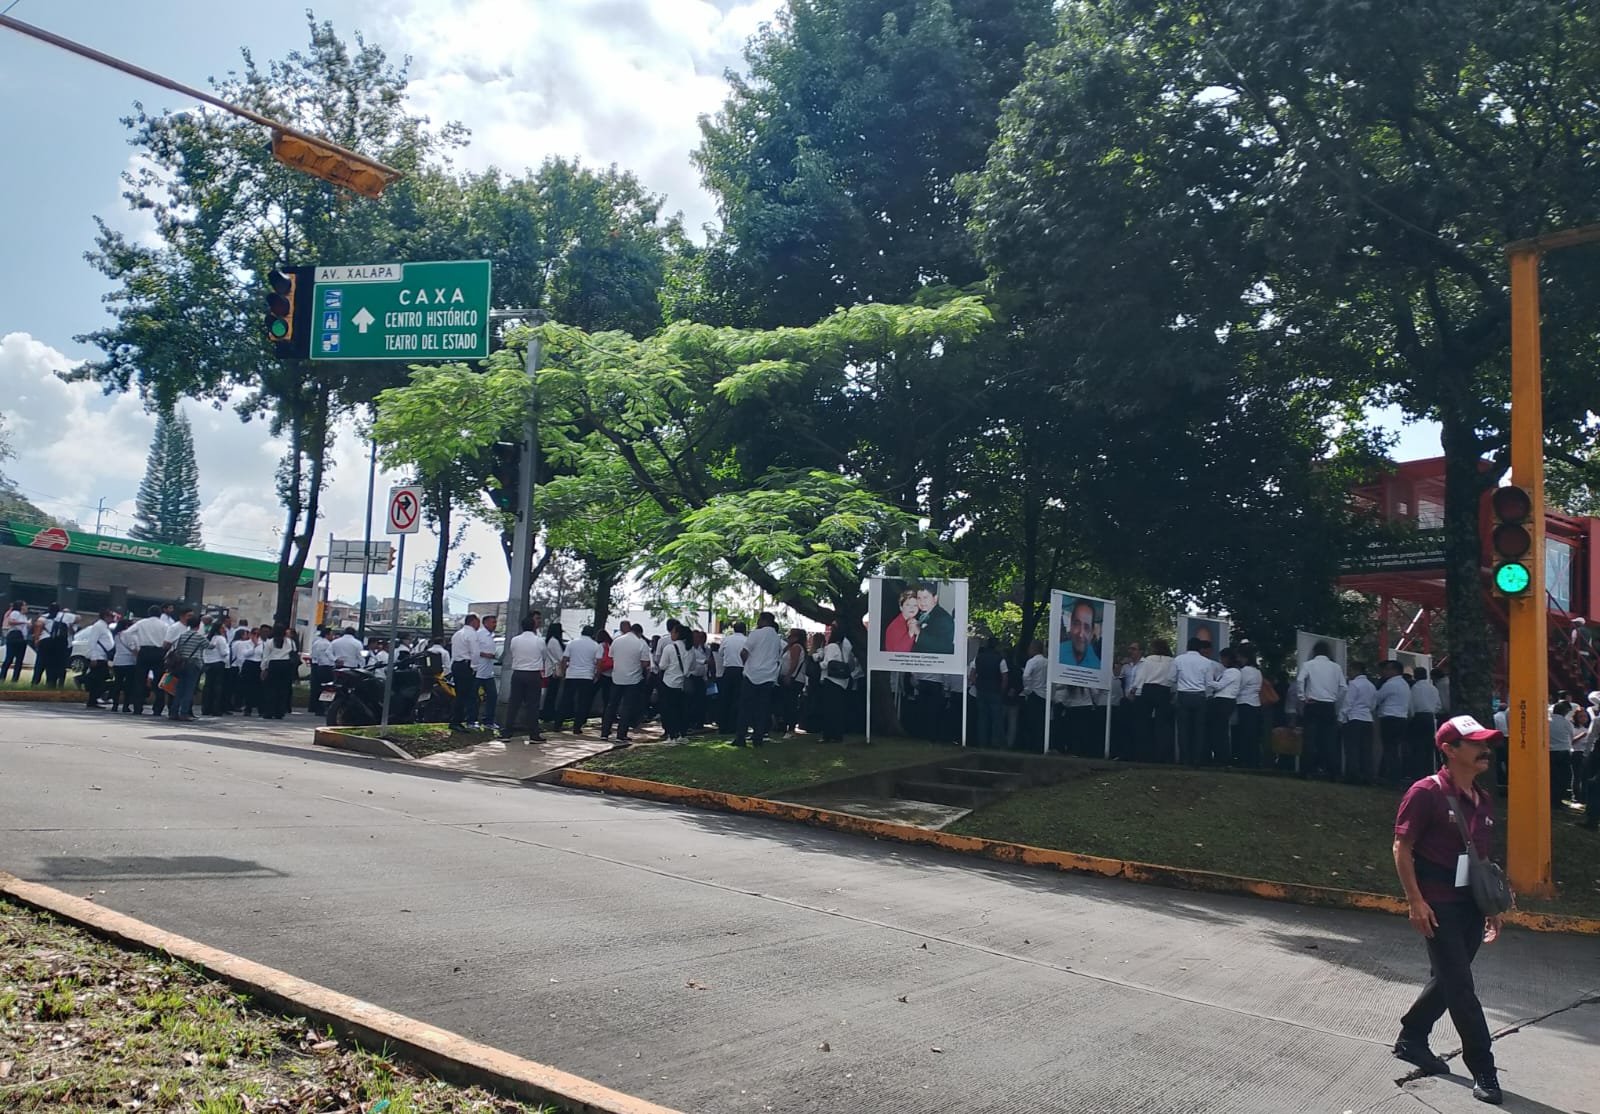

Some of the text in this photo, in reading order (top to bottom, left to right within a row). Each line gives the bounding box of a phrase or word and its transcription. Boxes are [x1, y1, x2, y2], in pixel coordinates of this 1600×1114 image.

[321, 267, 393, 280] AV. XALAPA
[399, 287, 465, 305] CAXA
[385, 306, 477, 328] CENTRO HISTÓRICO
[385, 333, 477, 350] TEATRO DEL ESTADO
[97, 541, 162, 558] PEMEX
